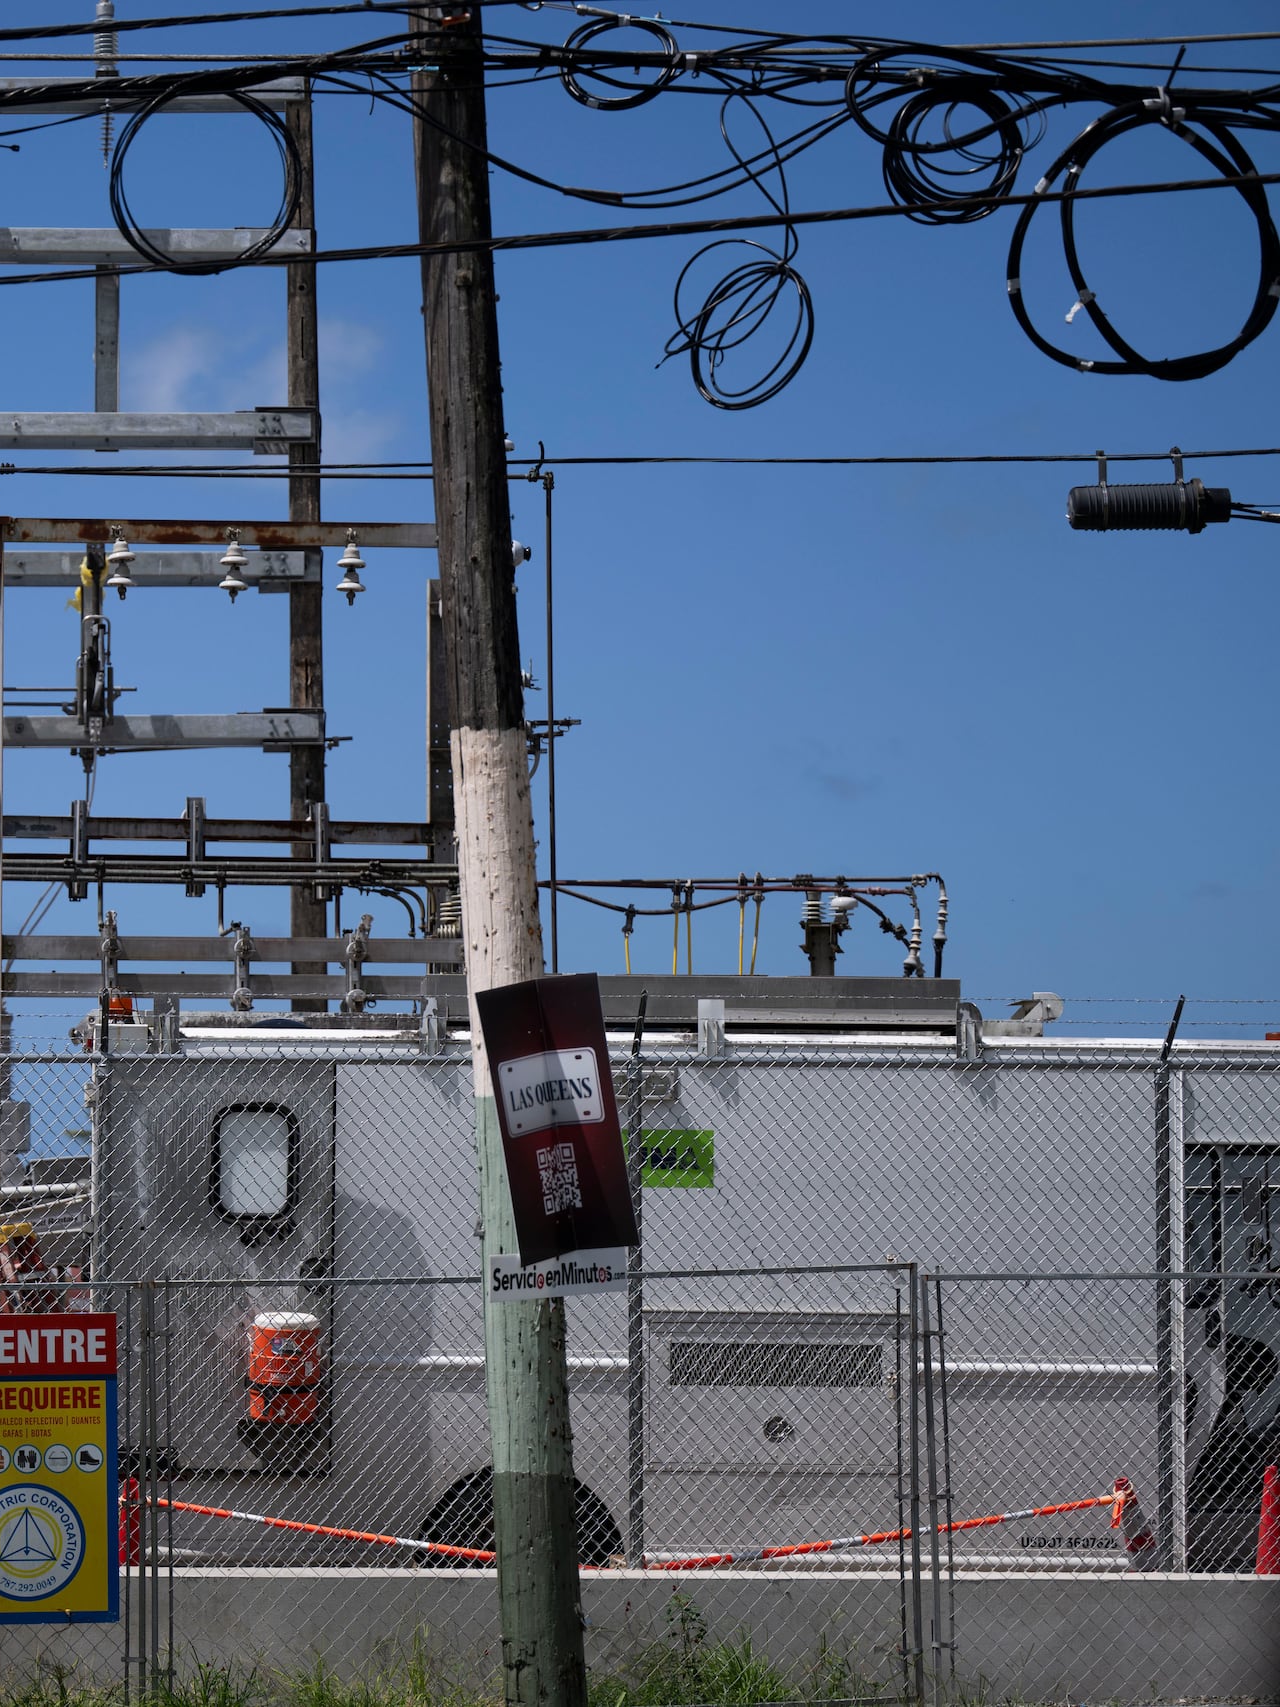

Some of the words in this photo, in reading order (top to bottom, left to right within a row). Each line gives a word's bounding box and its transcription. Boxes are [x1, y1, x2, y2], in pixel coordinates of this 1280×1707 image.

[510, 1086, 534, 1112] LAS
[535, 1077, 592, 1106] QUEENS
[24, 1416, 64, 1425] REFLECTIVO
[71, 1416, 101, 1425] GUANTES
[2, 1429, 23, 1438] GAFAS
[31, 1429, 52, 1437] BOTAS
[31, 1493, 77, 1570] CORPORATION
[1021, 1537, 1062, 1548] USDOT
[0, 1575, 57, 1593] 787.292.0049
